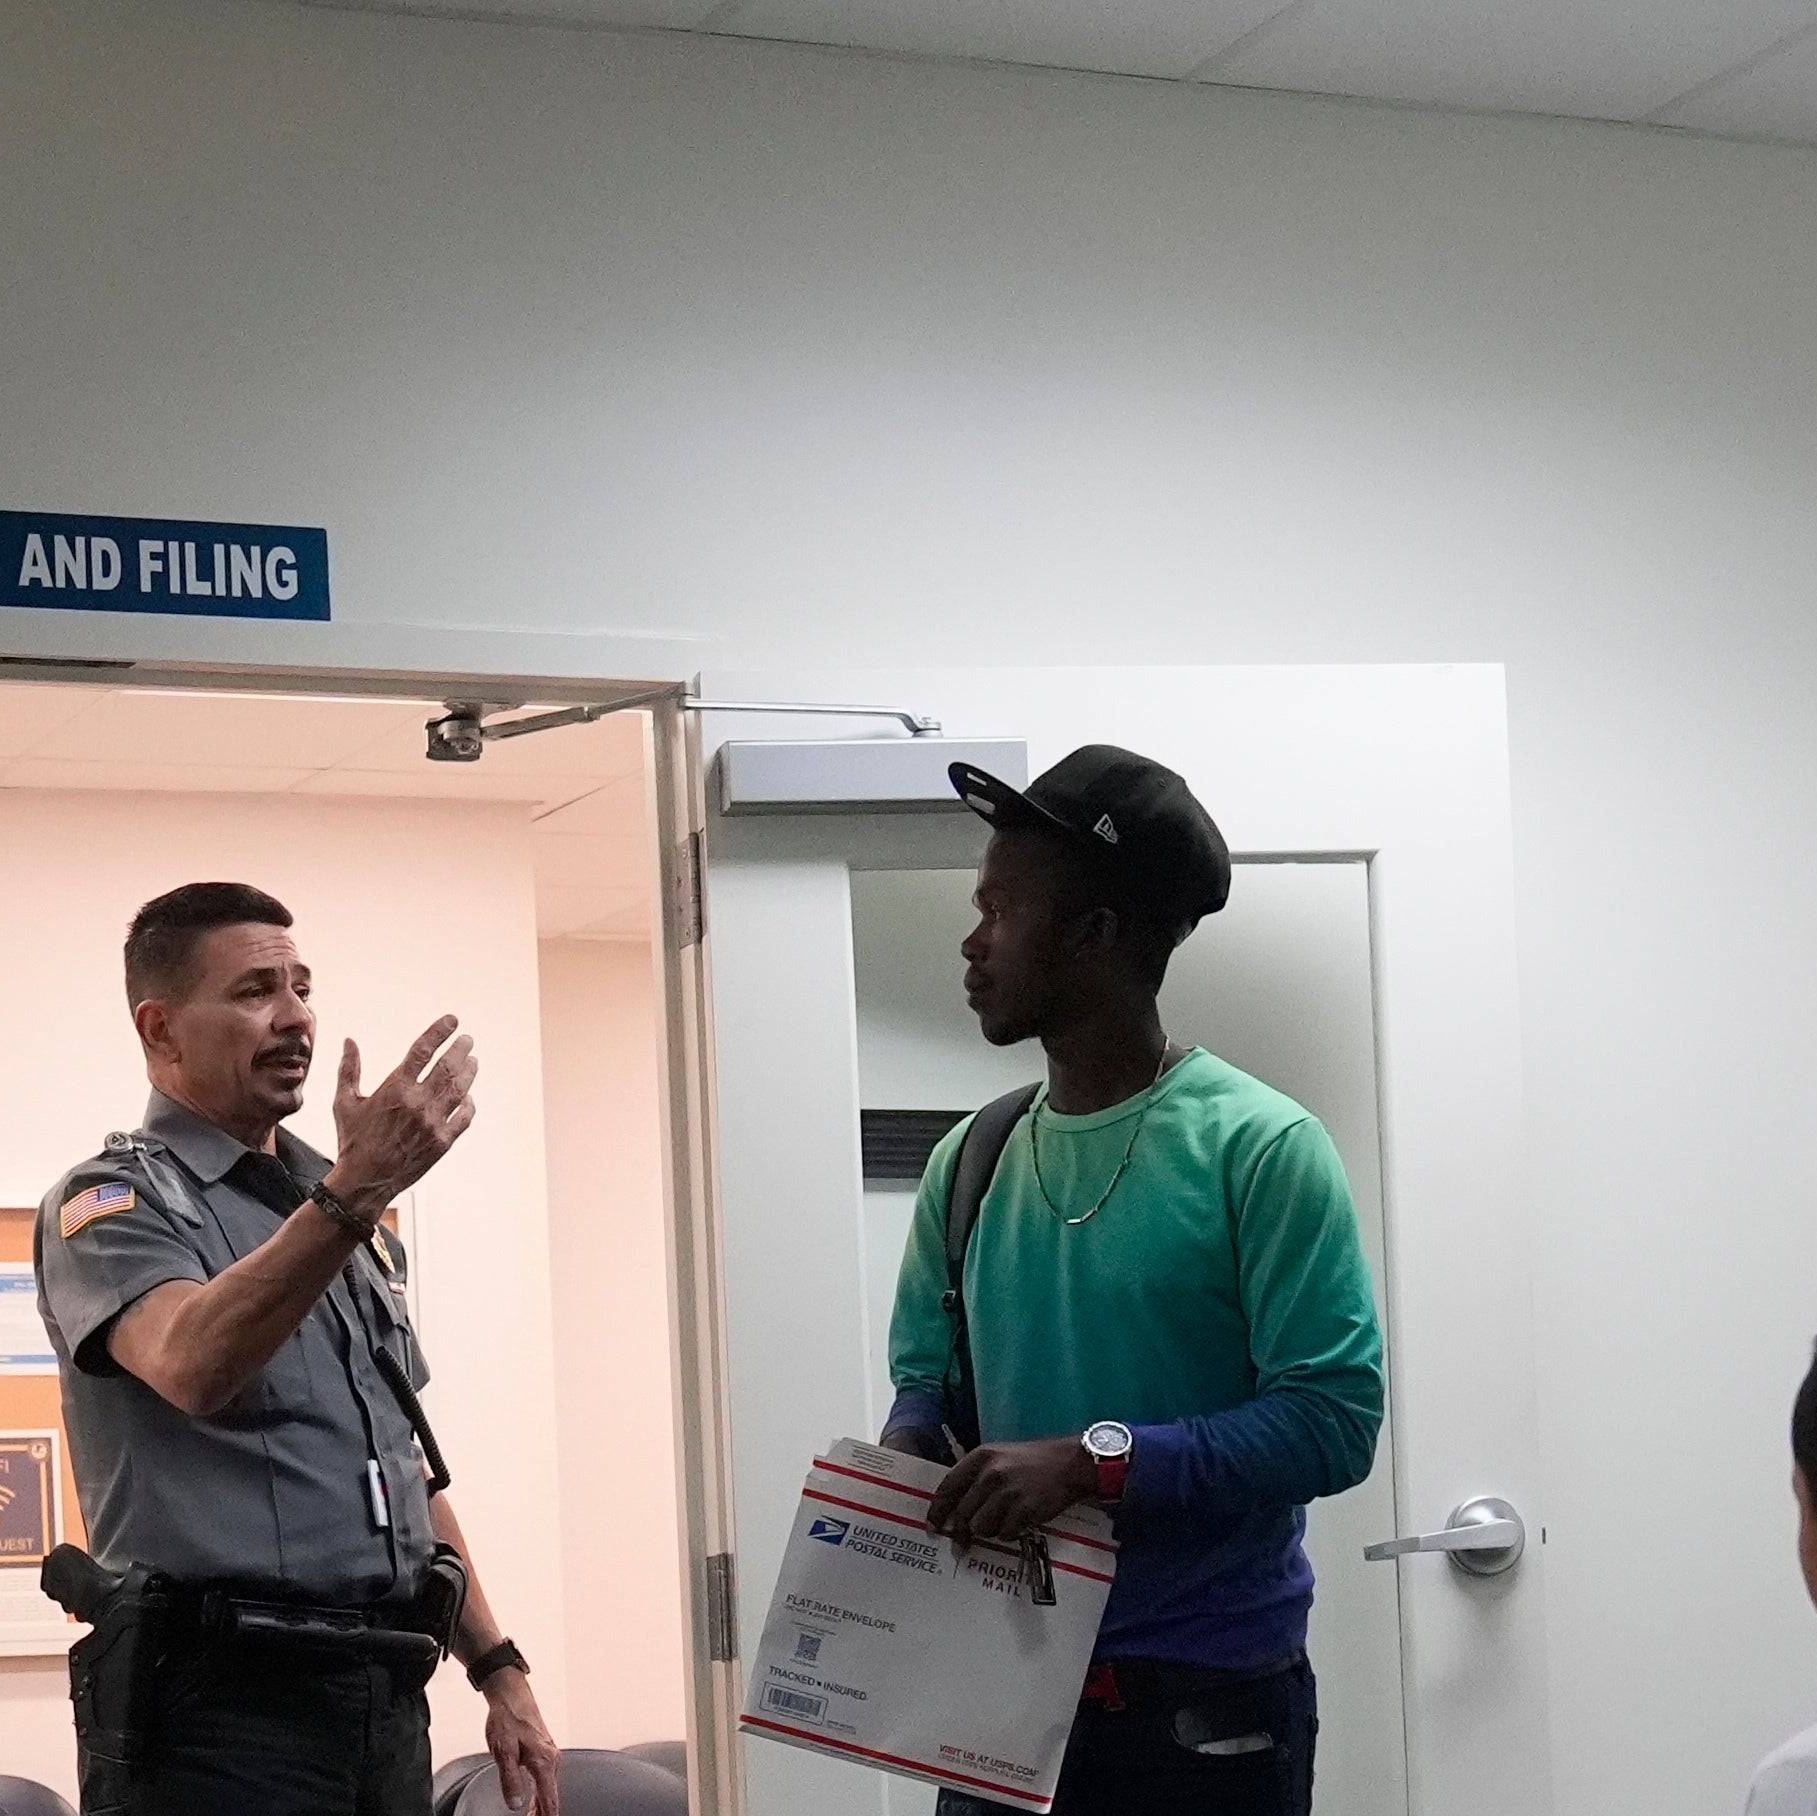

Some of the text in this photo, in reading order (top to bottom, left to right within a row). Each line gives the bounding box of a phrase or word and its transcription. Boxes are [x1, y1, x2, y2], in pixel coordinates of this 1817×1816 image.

[18, 533, 122, 591] AND
[139, 539, 299, 601] FILING
[845, 1538, 887, 1560] POSTAL
[853, 1525, 939, 1557] UNITED STATES
[981, 1577, 1020, 1598] MAIL
[786, 1593, 813, 1608] FLAT
[813, 1601, 842, 1617] RATE
[841, 1609, 897, 1633] ENVELOPE
[769, 1665, 868, 1701] TRACKED INSURED
[939, 1744, 962, 1757] VISIT
[963, 1749, 977, 1761] US
[977, 1754, 990, 1765] AT
